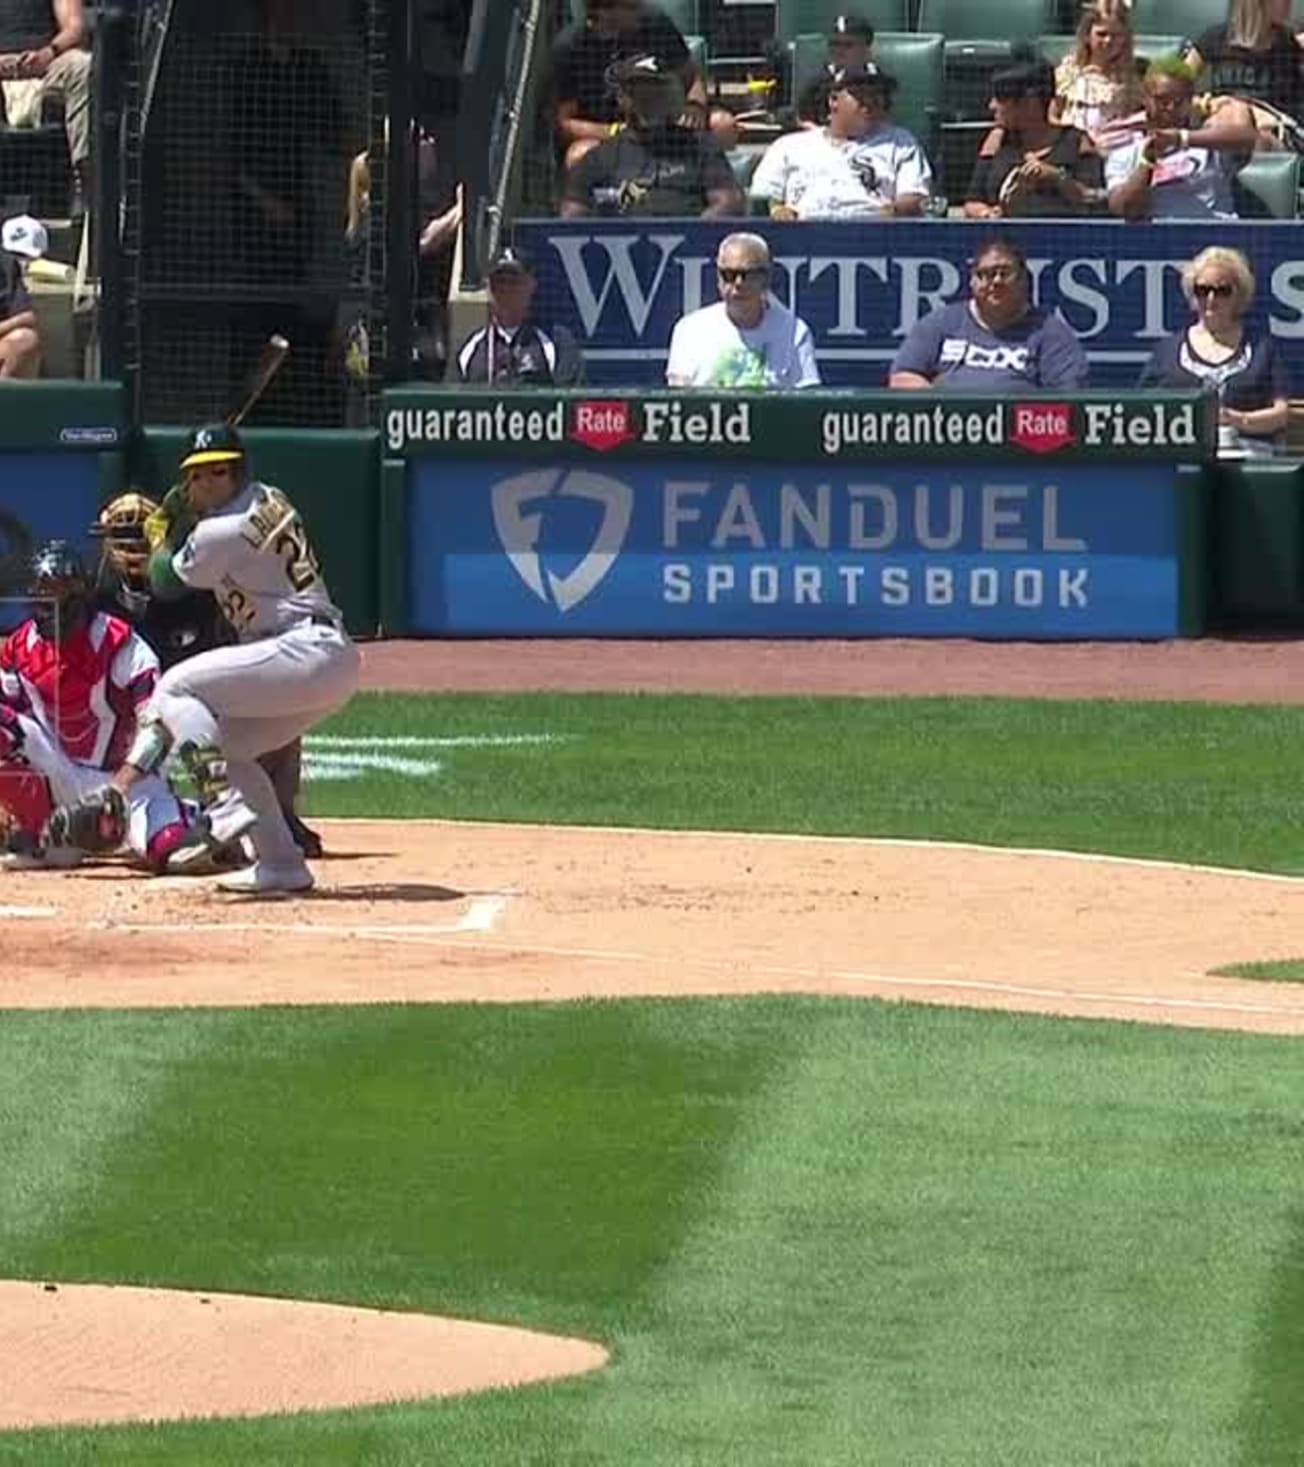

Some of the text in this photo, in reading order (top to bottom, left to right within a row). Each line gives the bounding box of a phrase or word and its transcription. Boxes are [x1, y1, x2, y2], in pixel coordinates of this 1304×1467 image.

[387, 402, 752, 449] guaranteed Rate Field
[823, 405, 1195, 453] guaranteed Rate Field
[662, 481, 1088, 552] FANDUEL
[663, 563, 1089, 606] SPORTSBOOK
